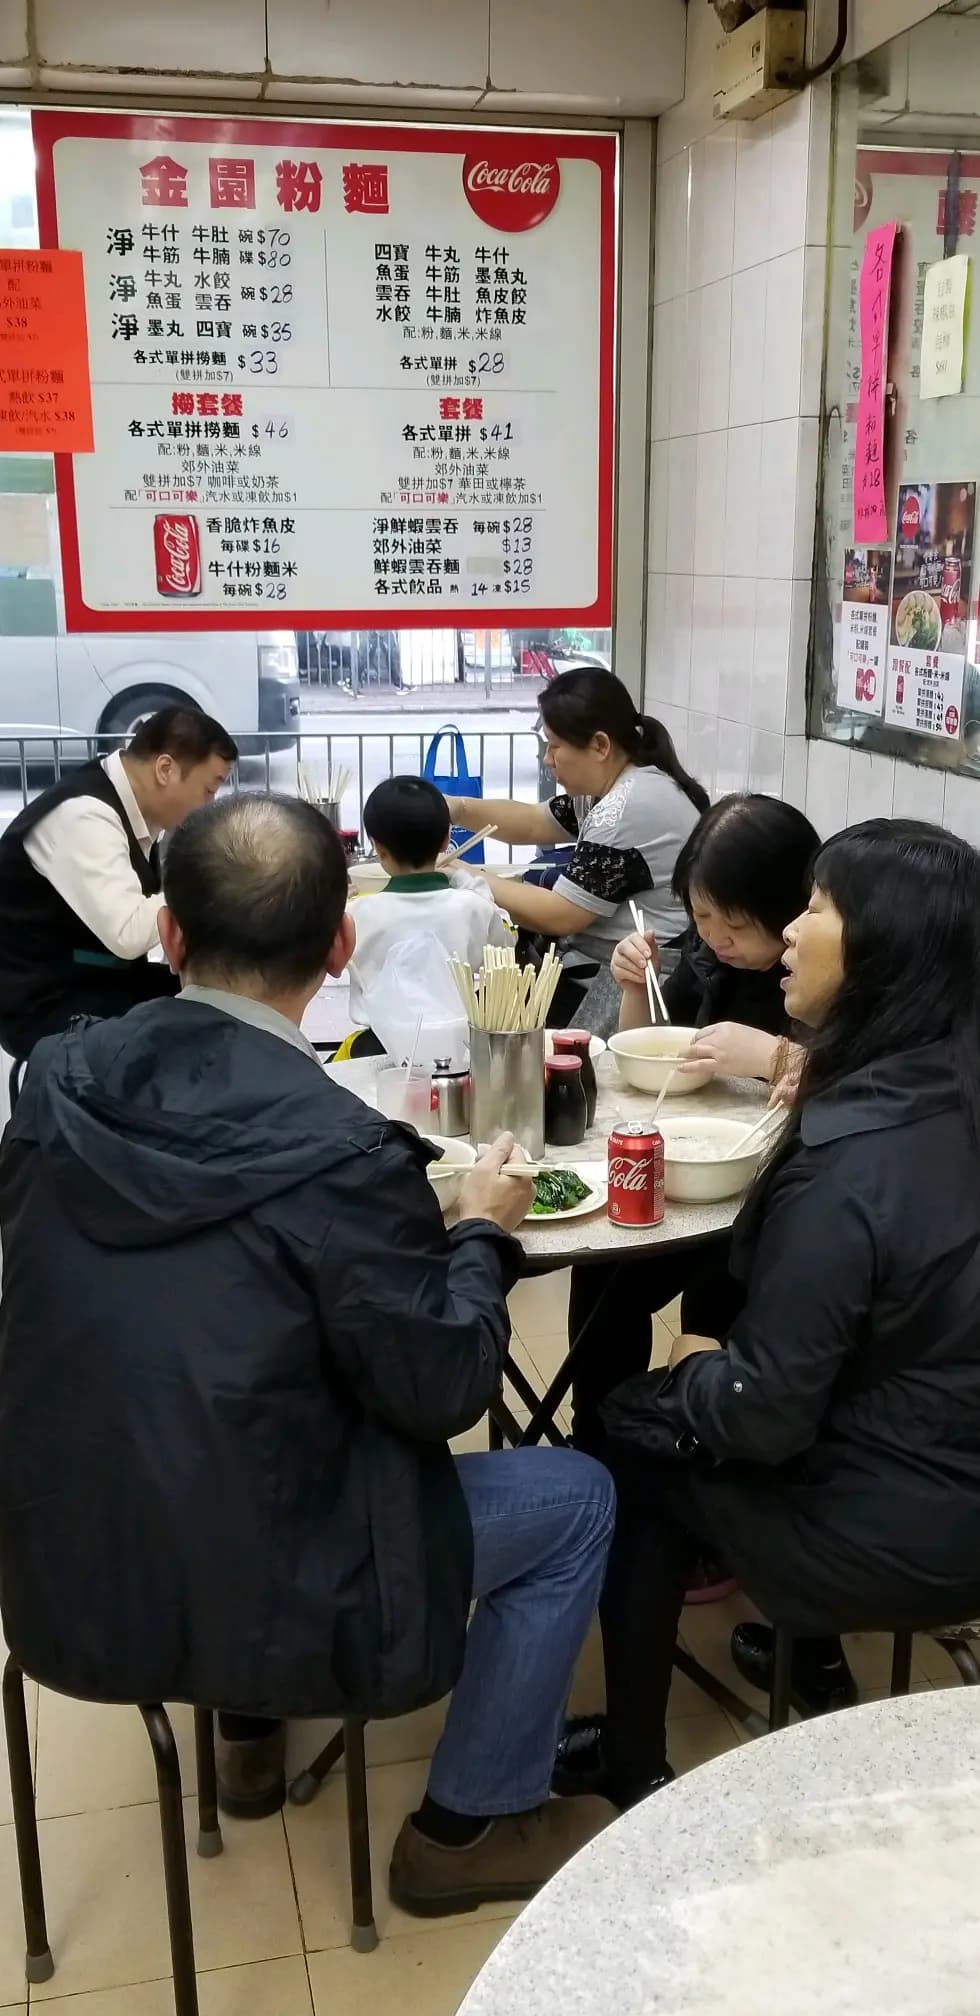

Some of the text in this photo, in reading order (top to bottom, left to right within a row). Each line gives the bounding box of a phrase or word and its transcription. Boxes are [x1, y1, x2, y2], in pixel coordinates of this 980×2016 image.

[139, 155, 390, 217] 金園粉麵
[467, 161, 554, 194] Coca-Cola
[106, 227, 135, 256] 淨
[142, 224, 180, 242] 牛什
[191, 224, 229, 243] 牛肚
[143, 246, 180, 264] 牛筋
[193, 247, 230, 265] 牛腩
[375, 244, 510, 264] 四寶 牛丸 牛什
[144, 270, 230, 289] 牛丸 水餃
[376, 265, 527, 285] 魚蛋 牛筋 墨魚丸
[109, 273, 138, 302] 淨
[376, 285, 527, 304] 雲吞 牛肚 魚皮餃
[146, 293, 232, 311] 魚蛋 雲吞
[376, 305, 527, 324] 水餃 牛腩 炸魚皮
[111, 312, 140, 341] 淨
[147, 319, 184, 337] 墨丸
[196, 320, 232, 338] 四寶
[133, 350, 227, 365] 各式單拼撈麵
[399, 356, 458, 371] 各式單拼
[439, 397, 484, 420] 套餐
[128, 420, 240, 438] 各式單拼撈麵
[402, 424, 471, 442] 各式單拼
[181, 461, 240, 473] 郊外油菜
[434, 463, 489, 476] 郊外油菜
[207, 475, 280, 489] 咖啡或奶茶
[206, 517, 296, 534] 香脆炸魚皮
[372, 518, 459, 534] 淨鮮蝦雲吞
[373, 538, 442, 554] 郊外油菜
[208, 561, 298, 577] 牛什粉麵米
[373, 559, 460, 575] 鮮蝦雲吞麵
[374, 579, 442, 595] 各式飲品
